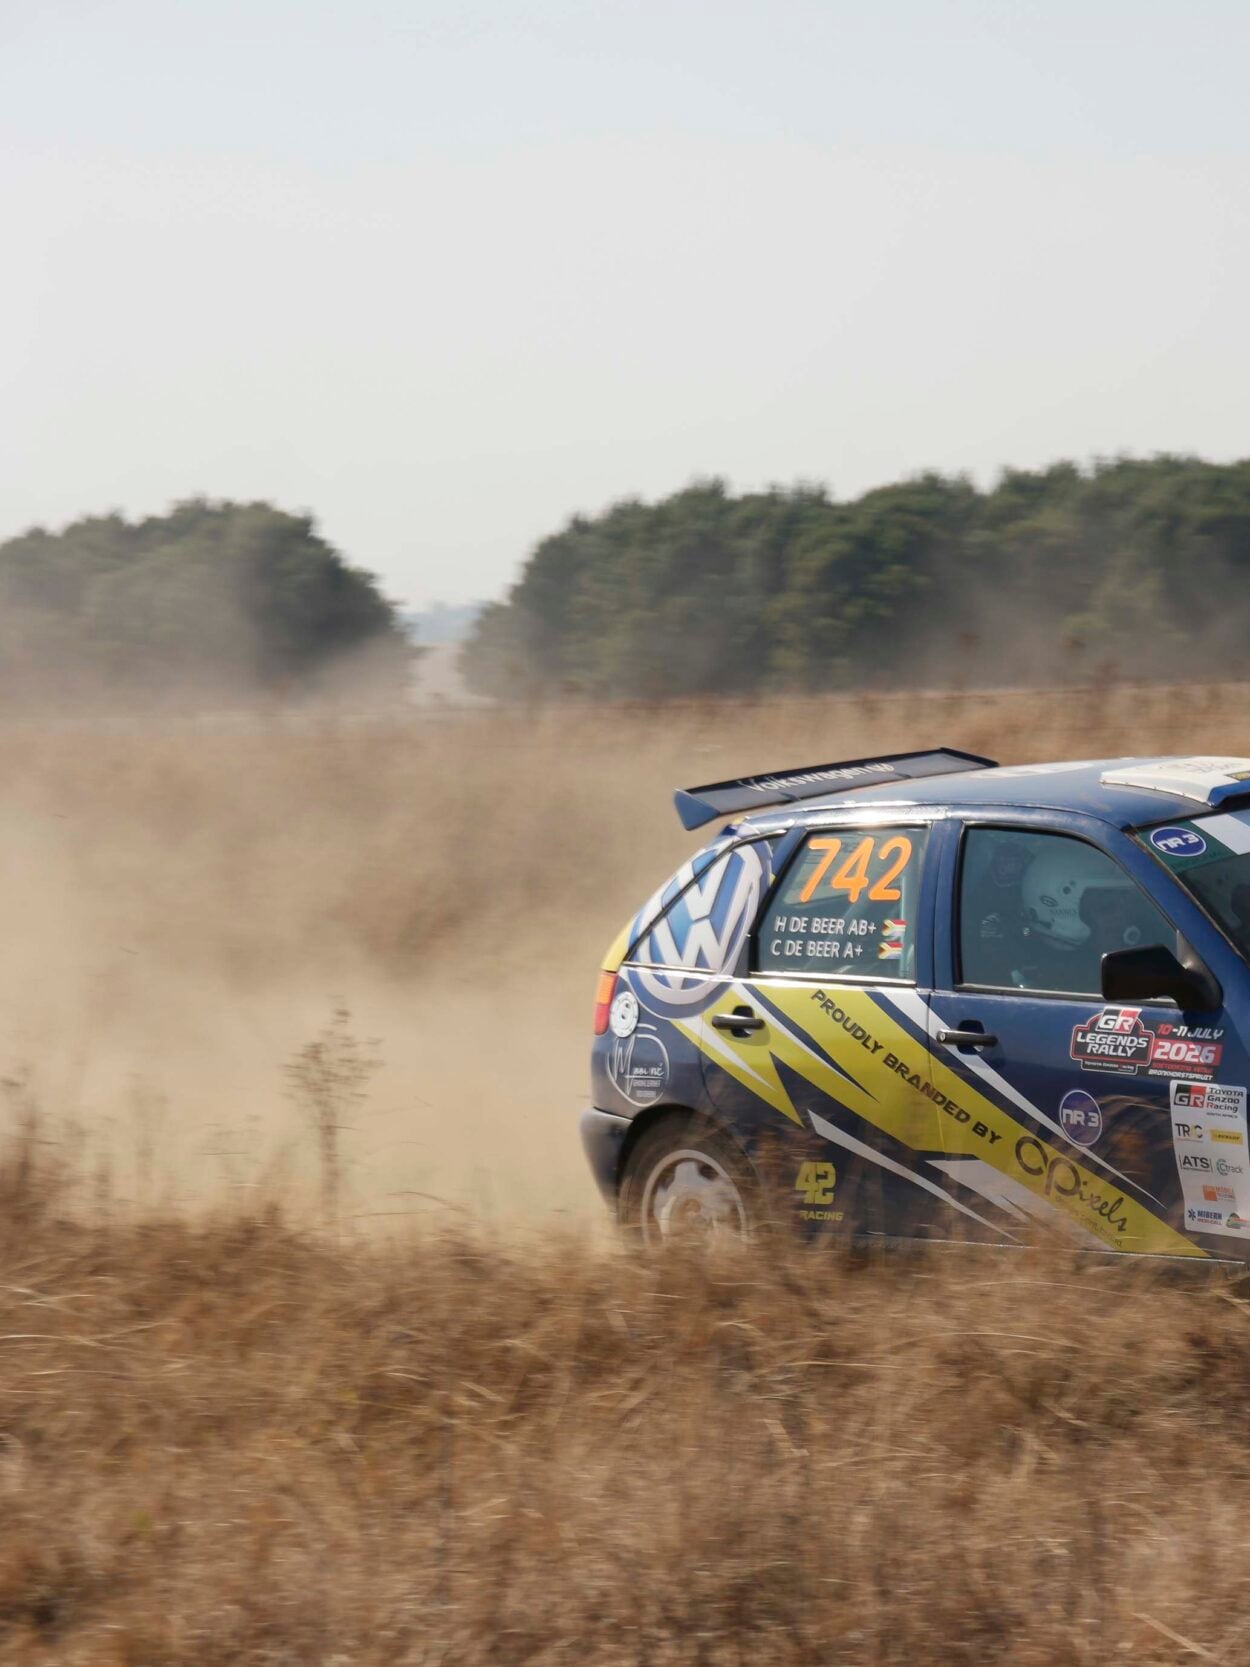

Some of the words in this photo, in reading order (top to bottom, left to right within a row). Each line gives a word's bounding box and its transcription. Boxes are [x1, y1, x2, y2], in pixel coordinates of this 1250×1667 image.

[1182, 834, 1199, 844] 3
[800, 836, 912, 903] 742
[774, 916, 787, 932] H
[789, 917, 809, 933] DE
[811, 918, 845, 935] BEER
[848, 920, 877, 935] AB+
[771, 940, 782, 956] C
[785, 941, 803, 957] DE
[806, 942, 840, 958] BEER
[843, 944, 863, 958] A+
[1099, 1014, 1135, 1031] GR
[1077, 1032, 1149, 1048] LEGENDS
[1187, 1025, 1223, 1040] JULY
[1087, 1043, 1136, 1057] RALLY
[1154, 1041, 1216, 1064] 2026
[810, 989, 884, 1054] PROUDLY
[882, 1053, 971, 1124] BRANDED
[971, 1121, 1002, 1144] BY
[1174, 1092, 1206, 1108] GR
[1209, 1086, 1244, 1097] TOYOTA
[1207, 1095, 1239, 1104] GAZOO
[1206, 1103, 1238, 1113] Racing
[1063, 1108, 1085, 1126] NR
[1087, 1111, 1099, 1127] 3
[1183, 1155, 1210, 1169] ATS
[795, 1162, 836, 1204] 42
